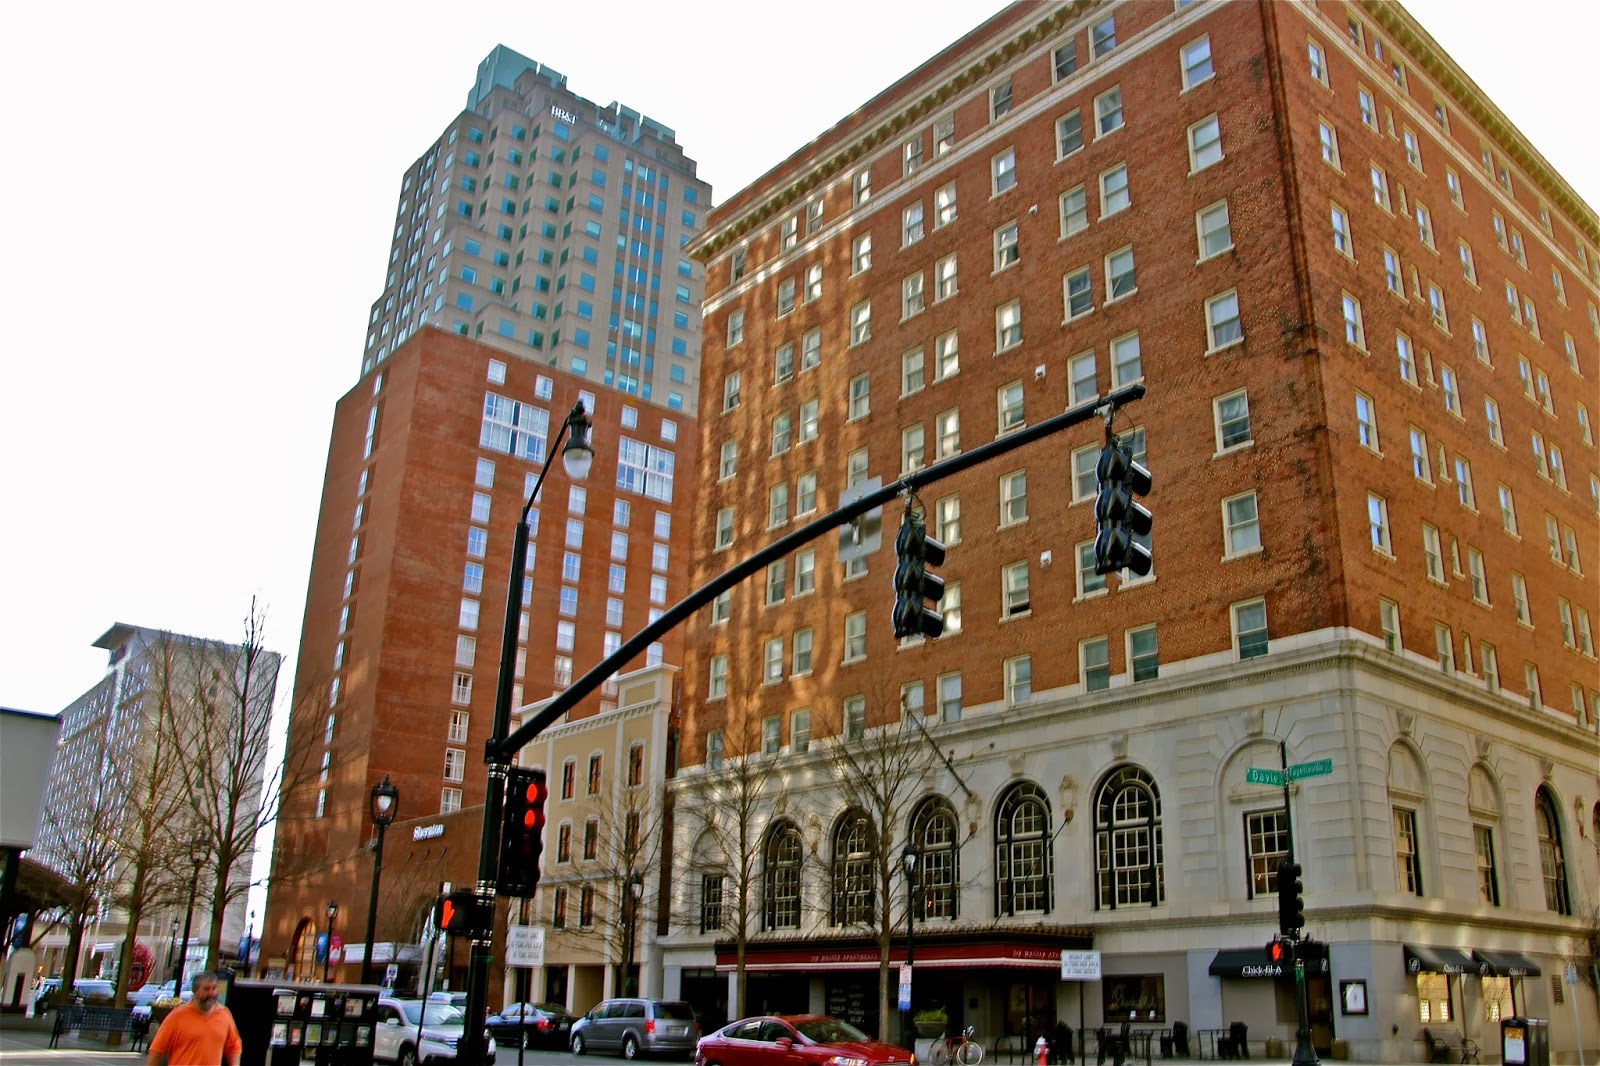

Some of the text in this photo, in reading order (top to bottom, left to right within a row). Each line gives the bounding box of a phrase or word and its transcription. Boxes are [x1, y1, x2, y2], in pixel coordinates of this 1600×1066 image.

[551, 105, 577, 125] BB&T
[1252, 769, 1278, 783] Davie
[413, 824, 444, 841] Sheraton
[1241, 965, 1282, 977] Chick-fil-A
